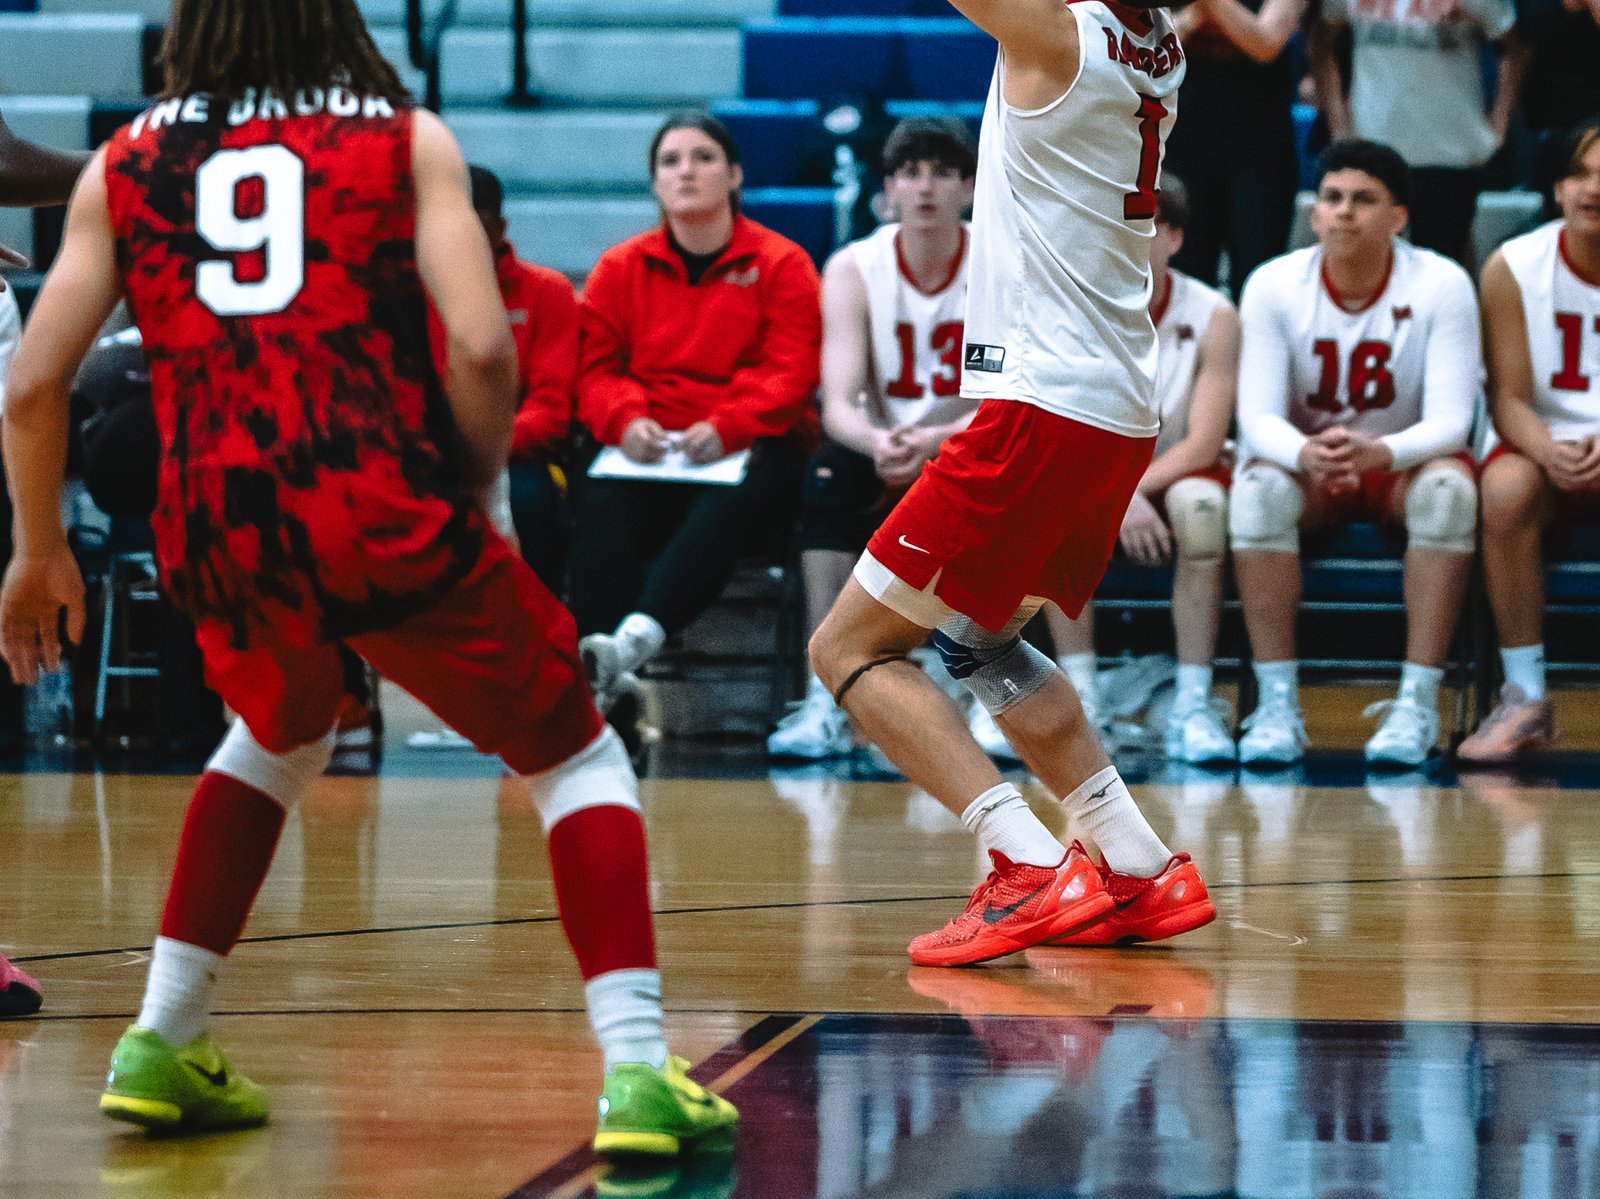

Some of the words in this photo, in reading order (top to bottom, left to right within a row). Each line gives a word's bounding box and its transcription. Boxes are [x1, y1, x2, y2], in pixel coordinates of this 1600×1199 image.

[1123, 92, 1169, 220] 1
[196, 144, 304, 316] 9
[886, 319, 964, 399] 13
[1551, 311, 1600, 392] 1
